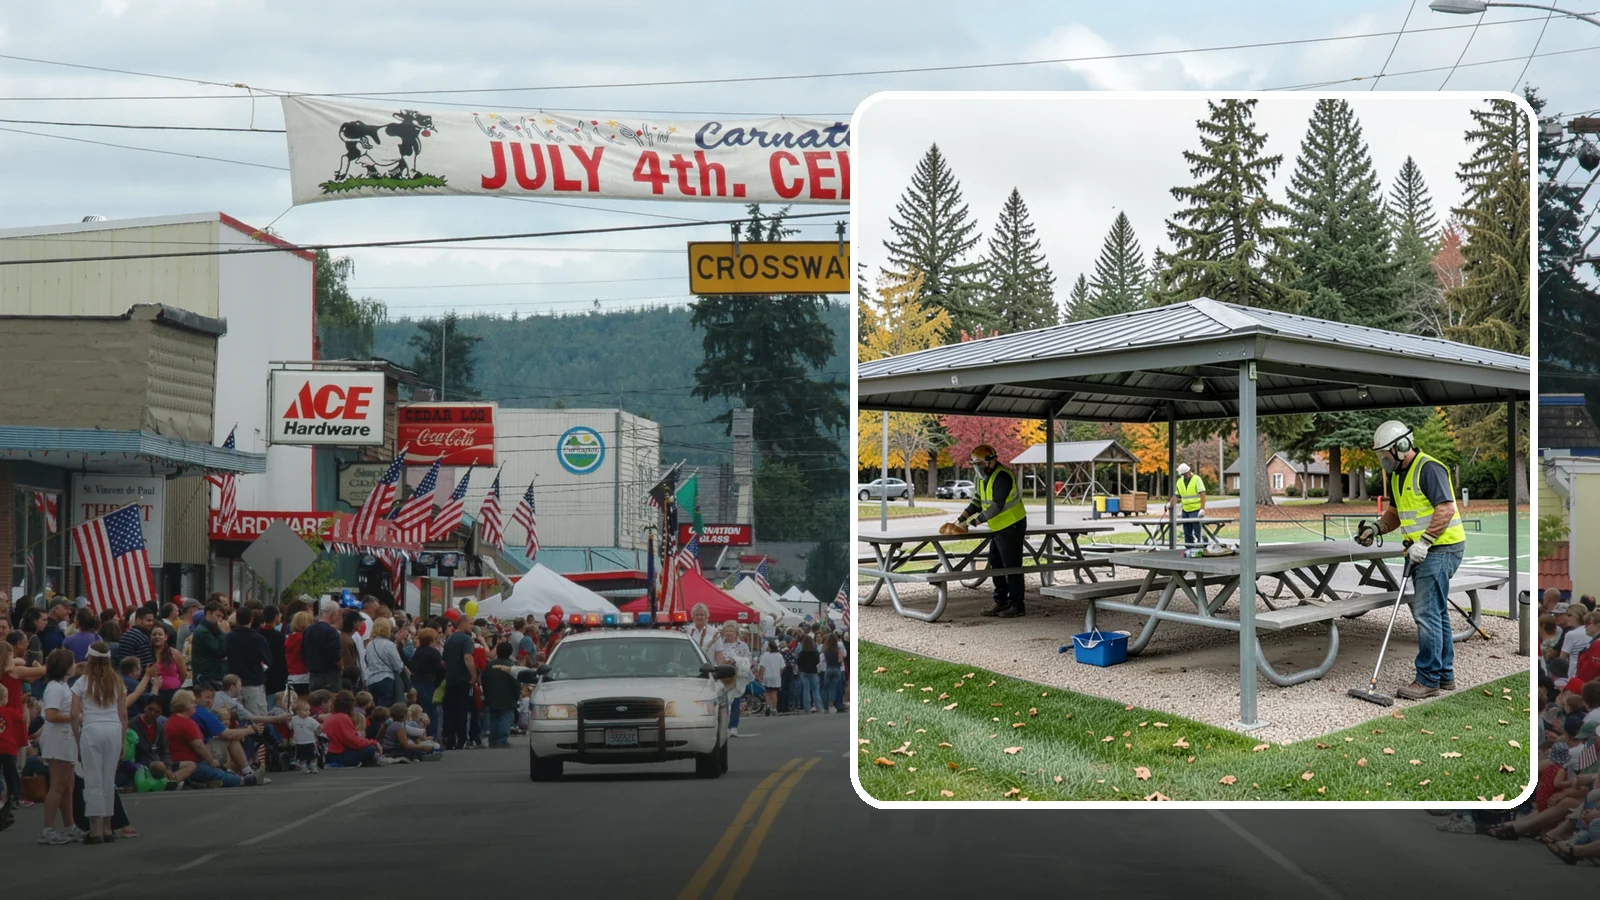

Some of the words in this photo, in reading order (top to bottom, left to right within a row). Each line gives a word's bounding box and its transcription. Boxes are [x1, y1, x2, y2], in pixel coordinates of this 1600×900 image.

[695, 121, 850, 150] Carnat
[481, 141, 605, 191] JULY
[632, 150, 746, 198] 4th.
[697, 254, 850, 280] CROSSWA
[282, 380, 373, 420] ACE
[405, 409, 453, 422] CEDAR
[283, 421, 371, 436] Hardware
[416, 428, 477, 447] Coca-Cola
[353, 467, 385, 482] Simpl
[96, 485, 124, 495] Vincent
[126, 486, 136, 495] de
[137, 486, 155, 495] Paul
[81, 503, 154, 522] THT
[212, 516, 331, 535] HARDARE
[688, 526, 742, 535] CRNATION
[699, 535, 730, 543] GLASS
